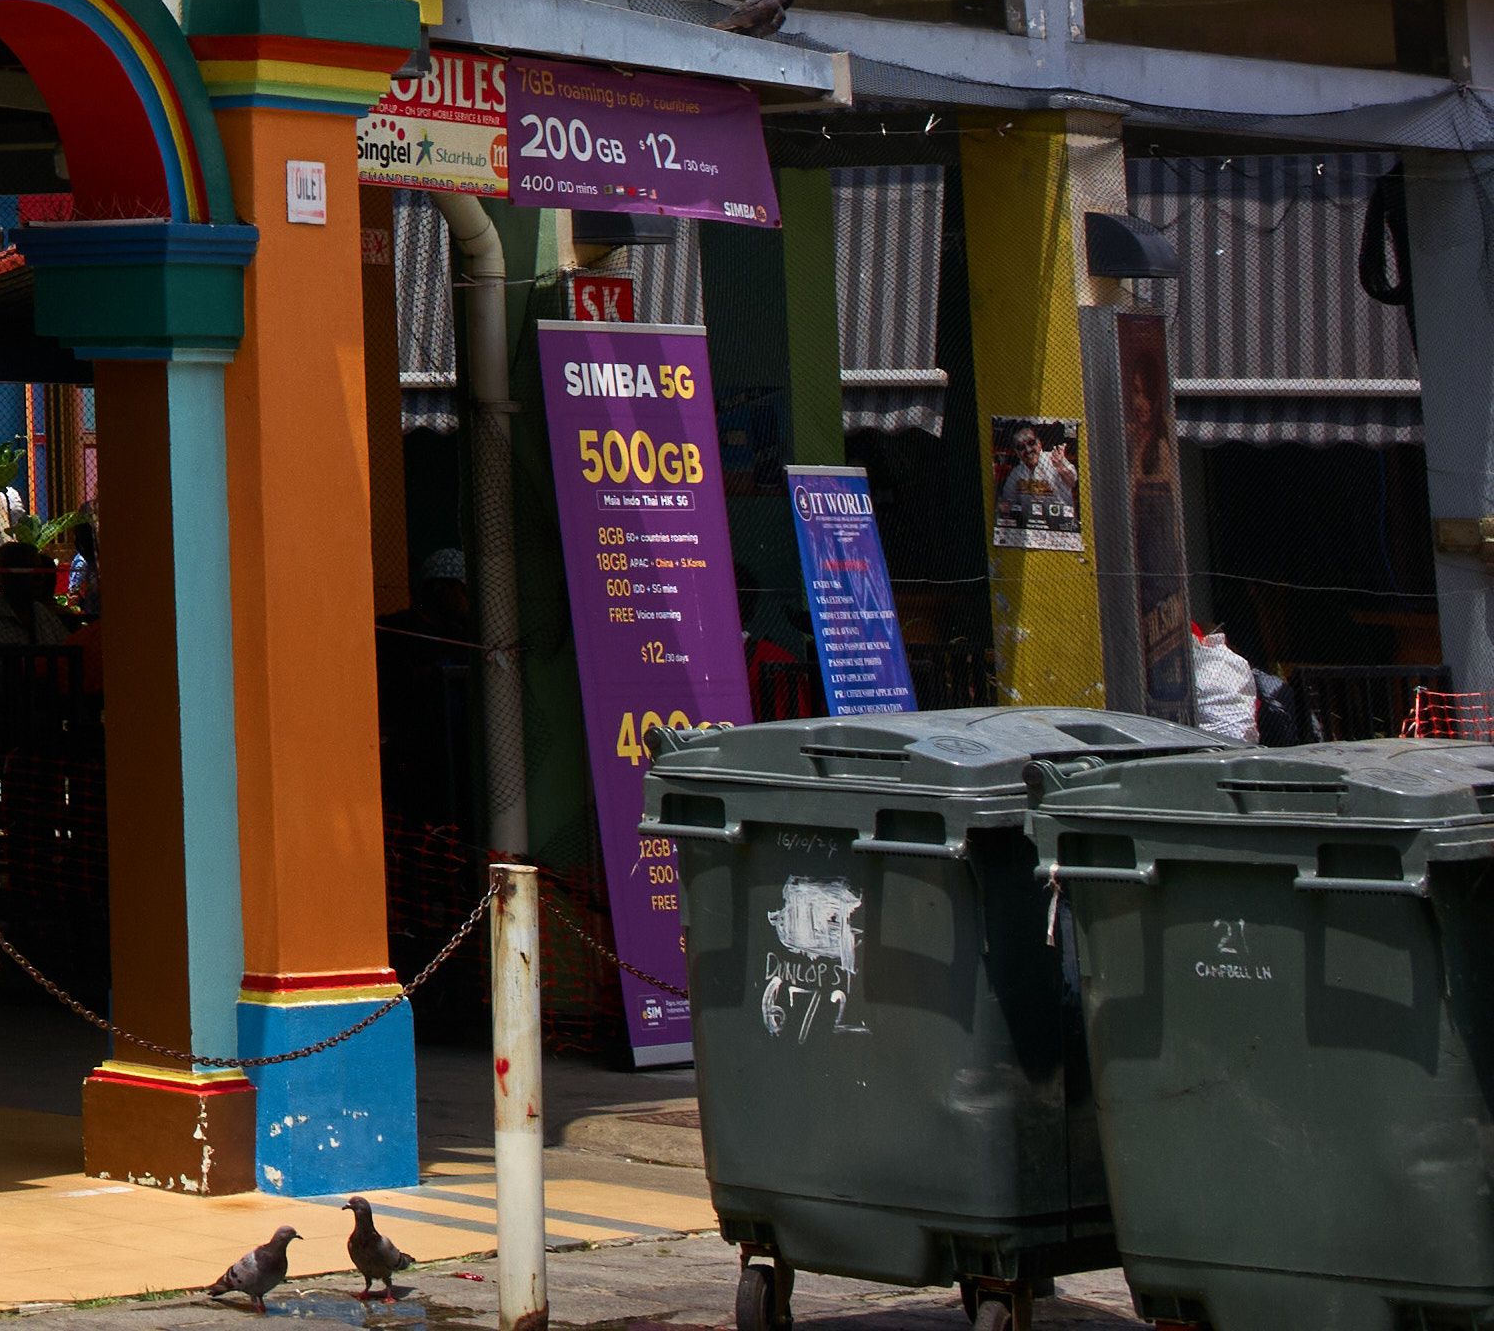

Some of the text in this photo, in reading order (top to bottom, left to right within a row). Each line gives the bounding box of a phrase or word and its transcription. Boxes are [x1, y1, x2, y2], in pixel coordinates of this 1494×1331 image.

[380, 56, 507, 113] OBILES
[516, 67, 555, 96] 7GB
[557, 83, 614, 108] roaming
[618, 93, 628, 106] to
[653, 99, 701, 115] countries
[357, 136, 411, 168] Singtel
[436, 148, 488, 167] StarHub
[698, 159, 719, 176] days
[521, 175, 599, 195] 400 IDD mins
[724, 201, 757, 220] SIMBA
[581, 284, 622, 322] SK
[564, 361, 695, 400] SIMBA 5G
[578, 429, 704, 484] 500GB
[603, 494, 621, 506] Msia
[642, 494, 659, 506] Thai
[660, 495, 675, 506] HK
[676, 495, 689, 507] SG
[809, 492, 873, 515] IT WORLD
[598, 527, 625, 545] 8GB
[640, 532, 670, 543] countries
[670, 532, 699, 545] roaming
[596, 553, 628, 571] 18GB
[606, 579, 631, 597] 600
[609, 607, 682, 623] FREE Voice roaming
[641, 641, 665, 664] $12
[639, 838, 671, 859] 12GB
[649, 865, 674, 884] 500
[651, 895, 678, 912] FREE
[1195, 961, 1252, 980] CAMPBELL
[762, 975, 873, 1045] 672
